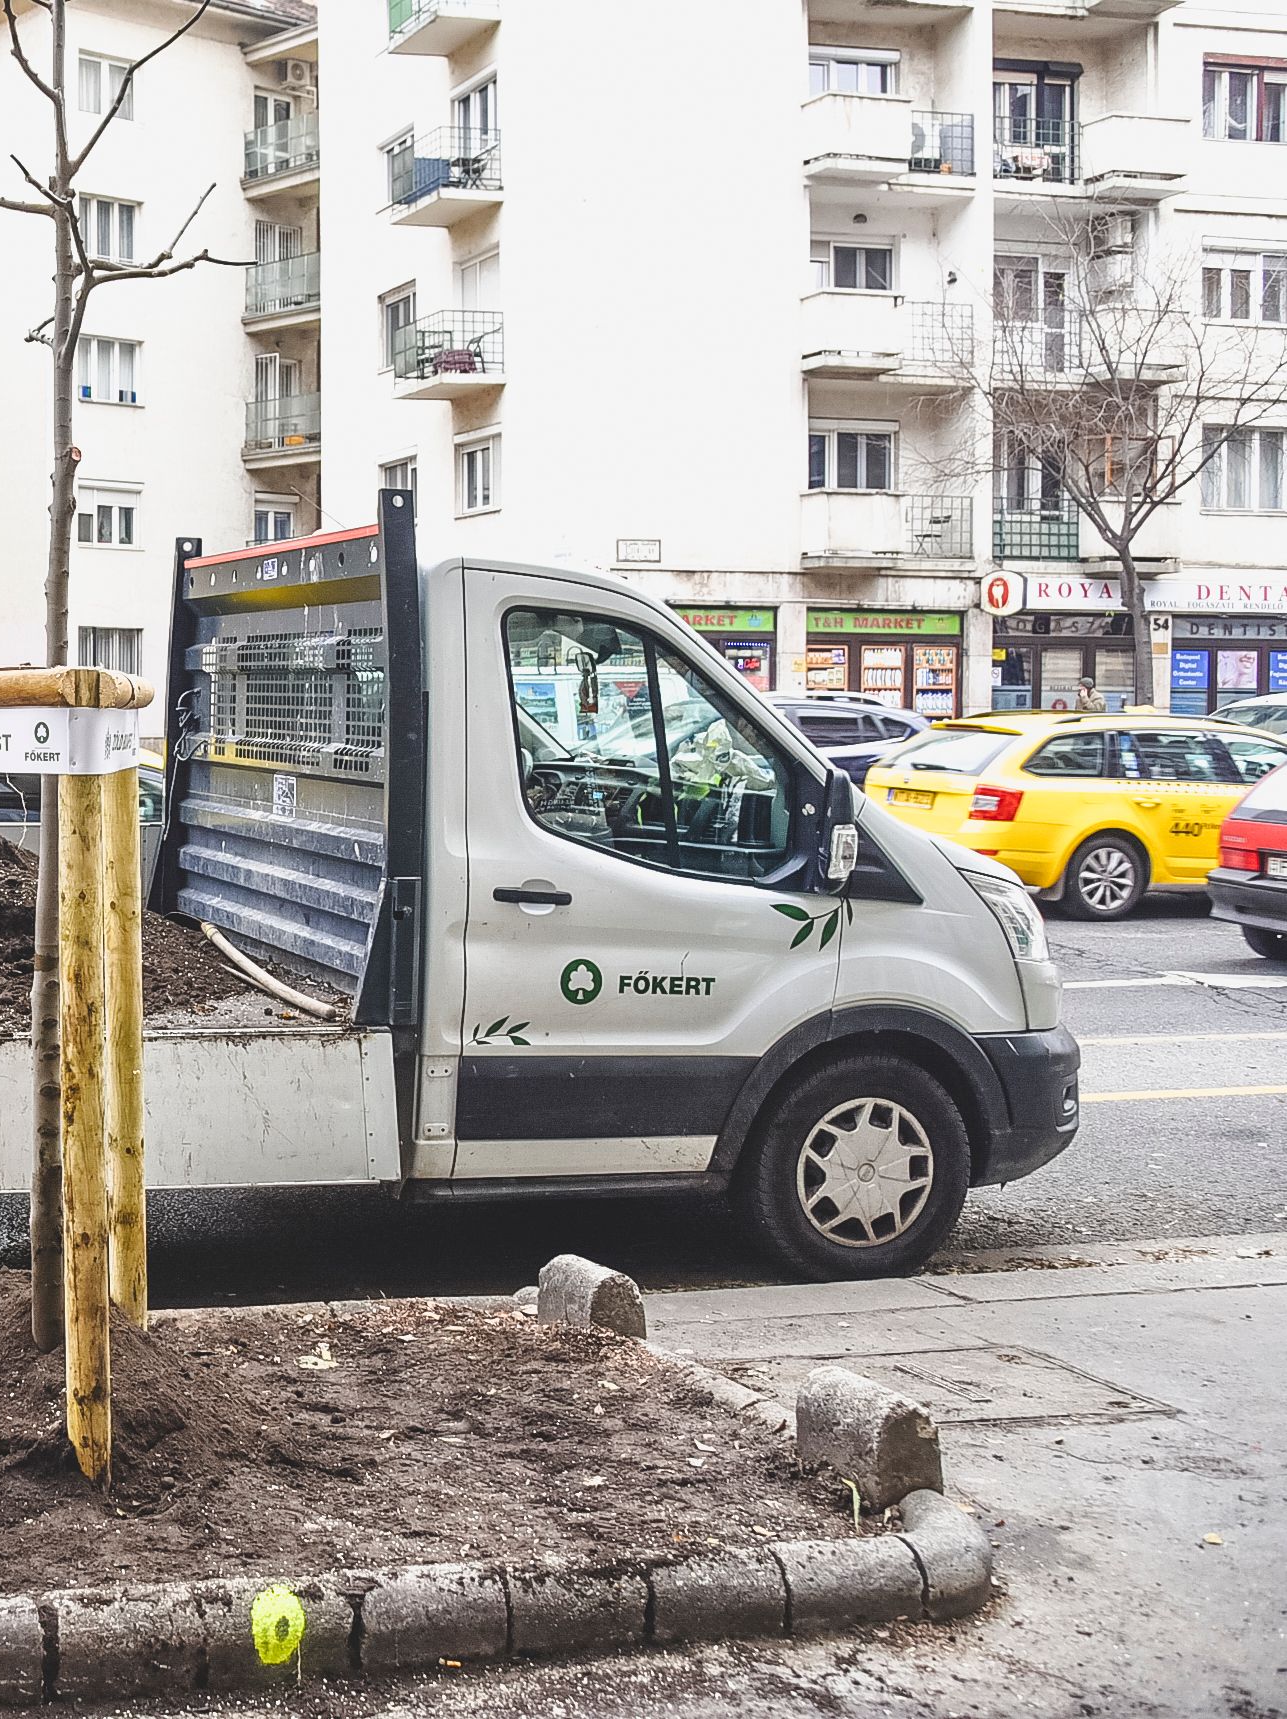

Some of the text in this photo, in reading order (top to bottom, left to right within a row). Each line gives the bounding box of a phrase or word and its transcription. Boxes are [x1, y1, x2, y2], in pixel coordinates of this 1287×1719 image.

[1038, 582, 1113, 599] ROYA
[1150, 600, 1178, 608] ROYAL
[682, 614, 737, 626] ARKET
[814, 616, 926, 629] T&H MARKET
[1152, 617, 1170, 632] 54
[24, 750, 61, 762] FŐKERT
[1169, 822, 1202, 837] 440
[618, 971, 716, 996] FŐKERT
